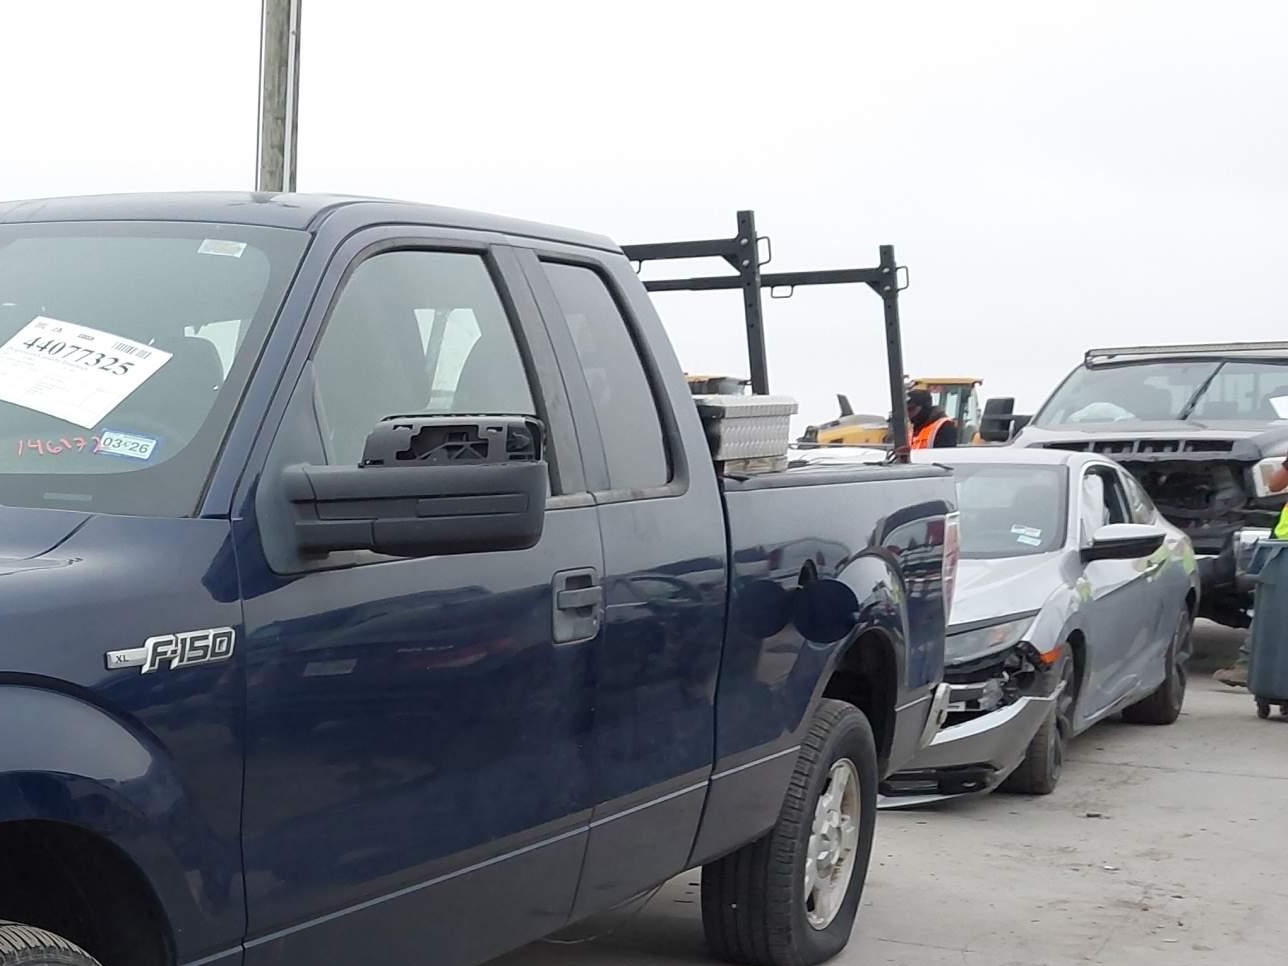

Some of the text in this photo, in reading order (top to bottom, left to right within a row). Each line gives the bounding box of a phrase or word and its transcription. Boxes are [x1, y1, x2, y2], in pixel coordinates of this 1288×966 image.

[23, 336, 135, 376] 44077325
[114, 627, 235, 673] XL F-150
